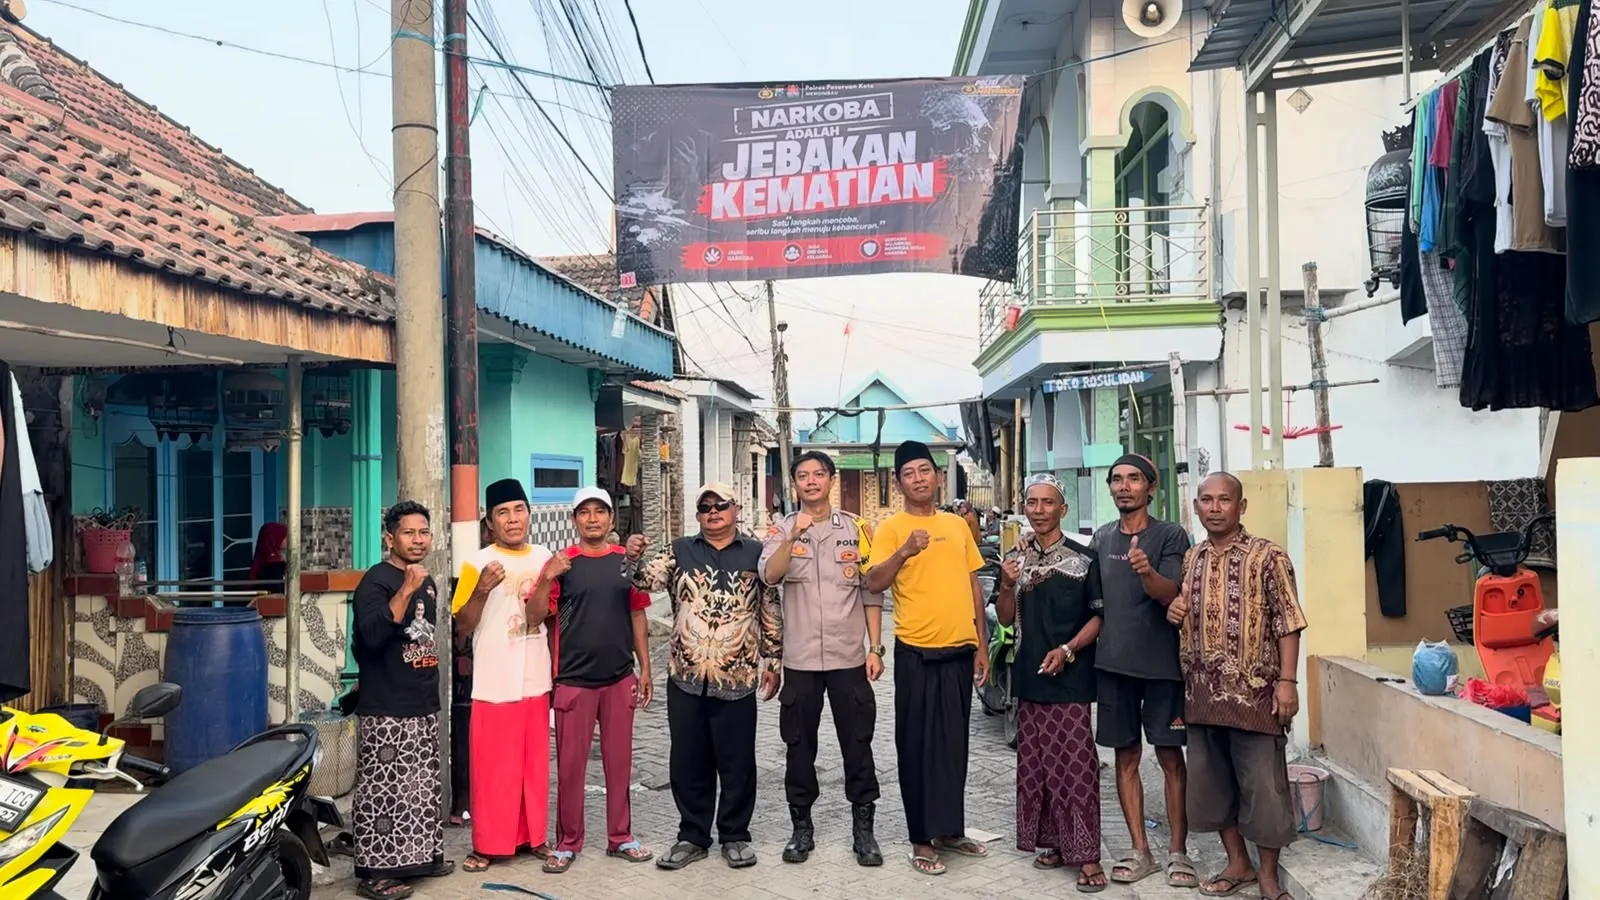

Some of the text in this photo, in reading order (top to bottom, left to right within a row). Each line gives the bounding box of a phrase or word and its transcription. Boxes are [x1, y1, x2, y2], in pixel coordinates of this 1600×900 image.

[751, 99, 881, 129] NARKOBA
[785, 125, 840, 140] ADALAH
[721, 131, 917, 181] JEBAKAN
[711, 162, 934, 220] KEMATIAN
[746, 227, 770, 236] seribu
[770, 225, 801, 236] langkah
[802, 224, 831, 234] menuju
[790, 217, 821, 228] langkah
[1046, 370, 1145, 392] TOKO ROSULIDAH
[836, 539, 860, 547] POLR
